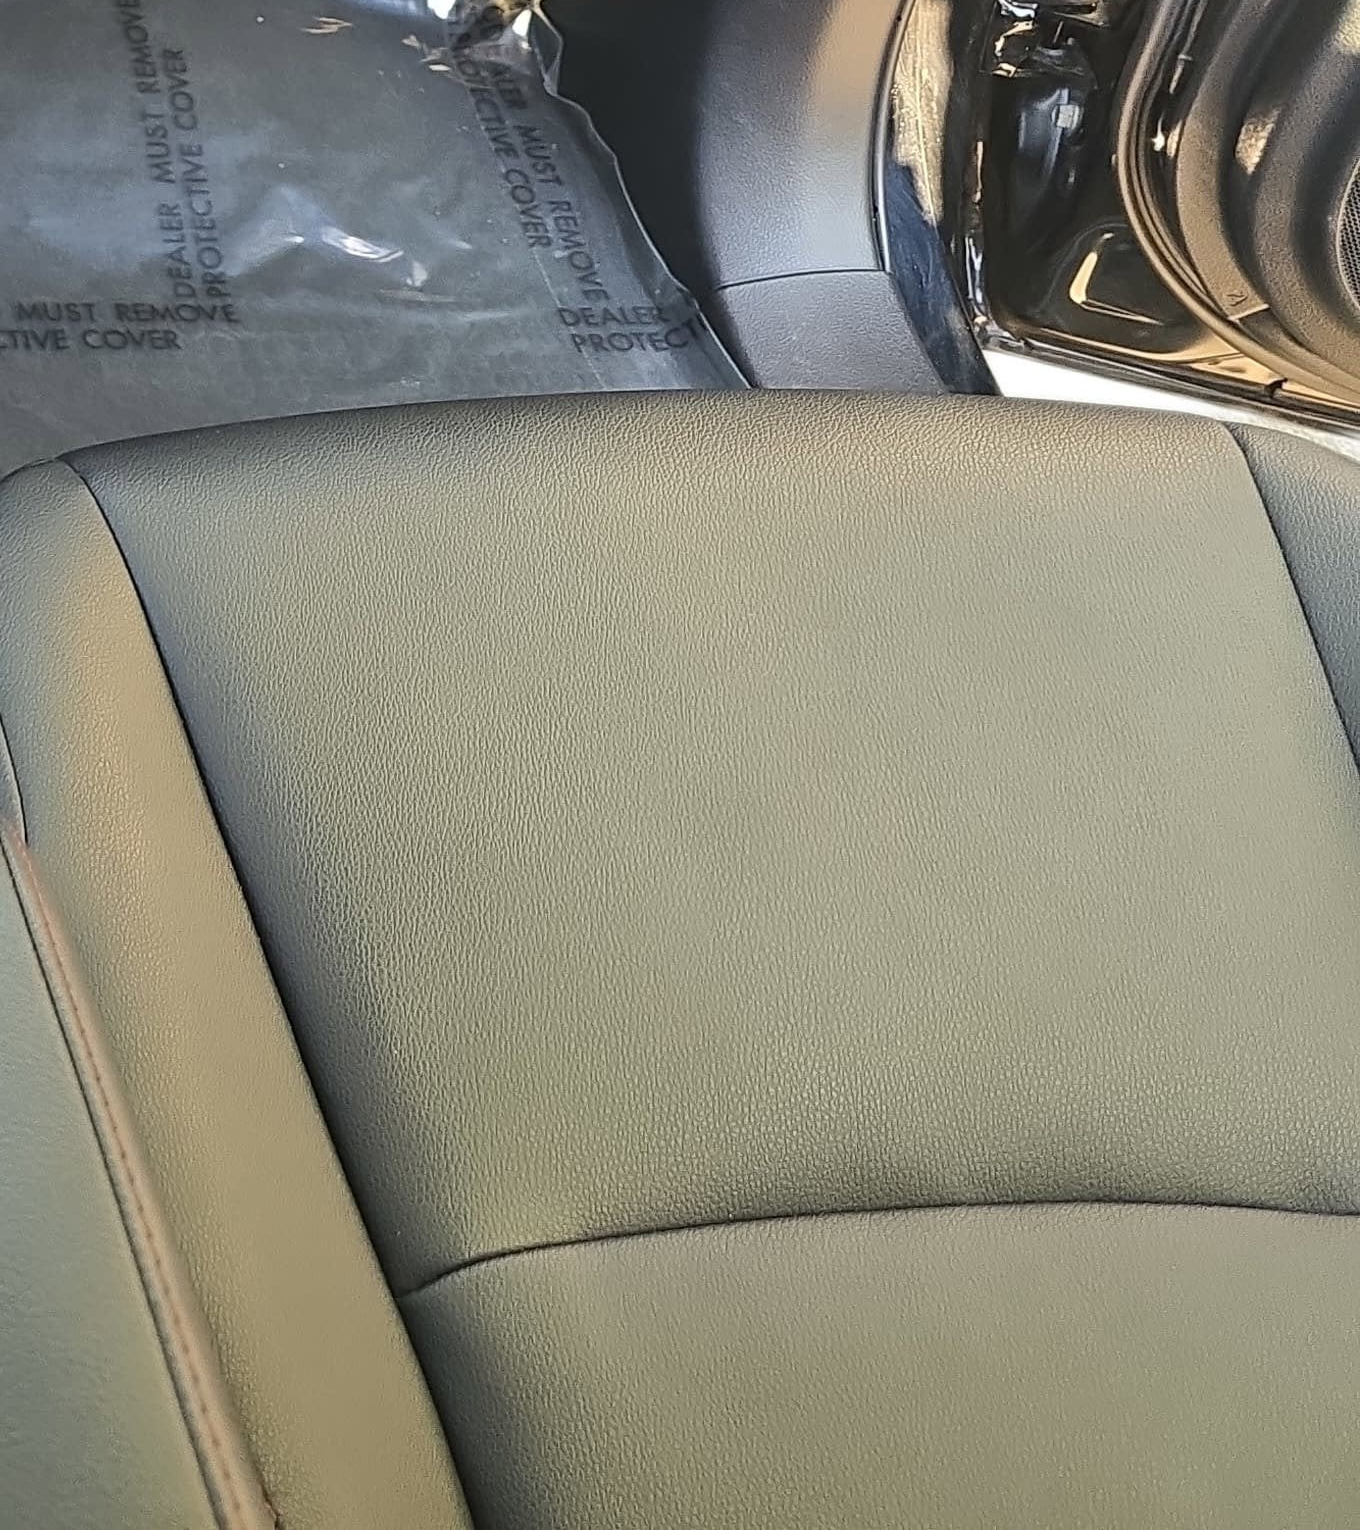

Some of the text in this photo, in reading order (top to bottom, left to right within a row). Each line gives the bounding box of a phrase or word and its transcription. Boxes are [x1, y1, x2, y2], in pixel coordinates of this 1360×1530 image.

[144, 112, 177, 185] MUST
[160, 46, 233, 298] PROTECTIVE COVER
[503, 167, 553, 250] COVER
[511, 125, 564, 187] MUST
[546, 200, 611, 303] REMOVE
[156, 202, 197, 299] DEALER
[15, 300, 98, 324] MUST
[114, 301, 242, 324] REMOVE
[81, 328, 182, 351] COVER
[556, 305, 672, 327] DEALER
[570, 321, 698, 353] PROTECT
